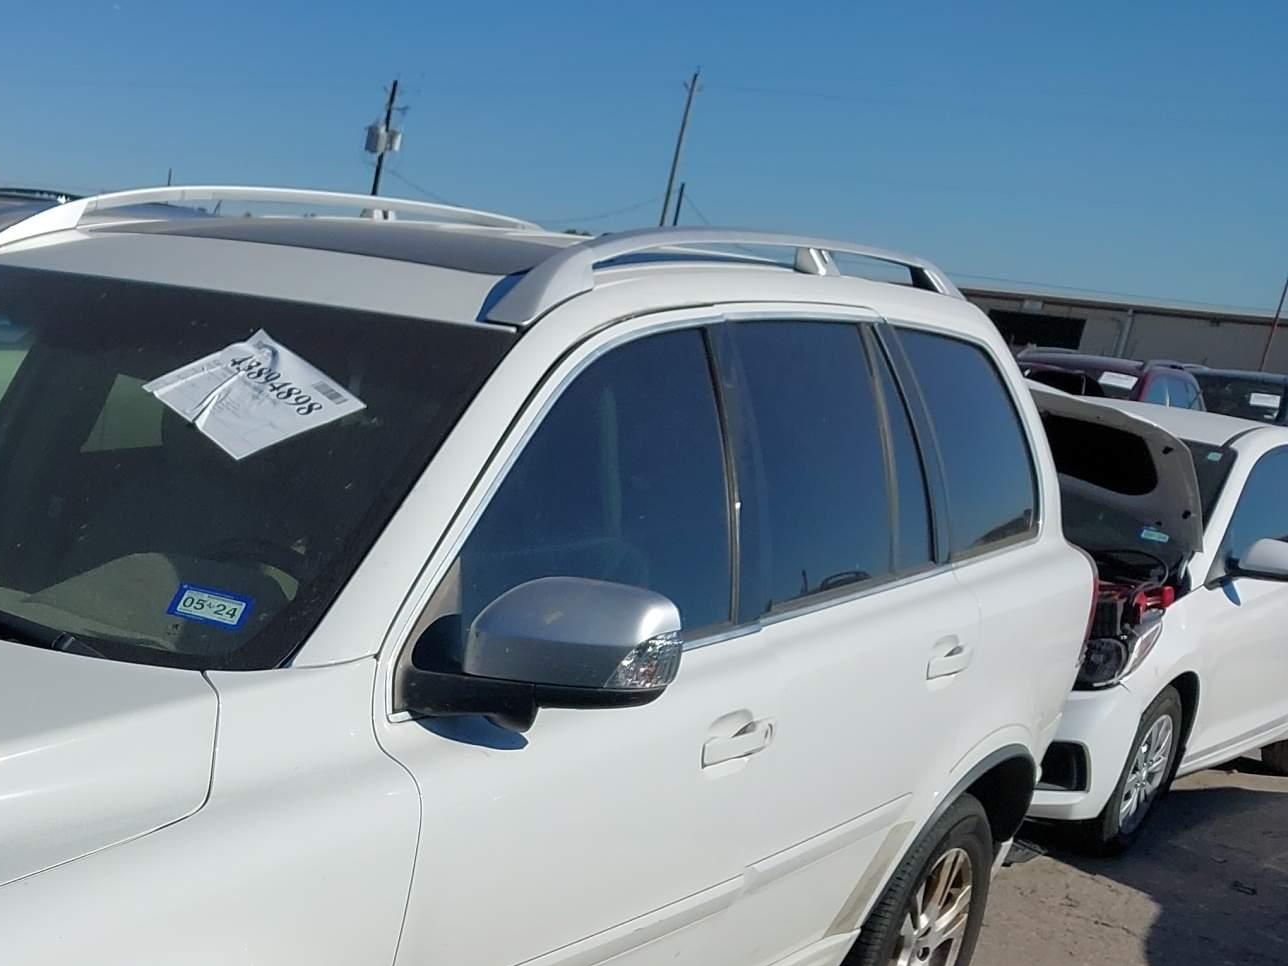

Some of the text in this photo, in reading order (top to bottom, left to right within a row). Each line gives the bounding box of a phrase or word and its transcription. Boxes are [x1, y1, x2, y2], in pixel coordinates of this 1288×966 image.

[230, 354, 323, 416] 43894898
[182, 596, 238, 619] 05 24
